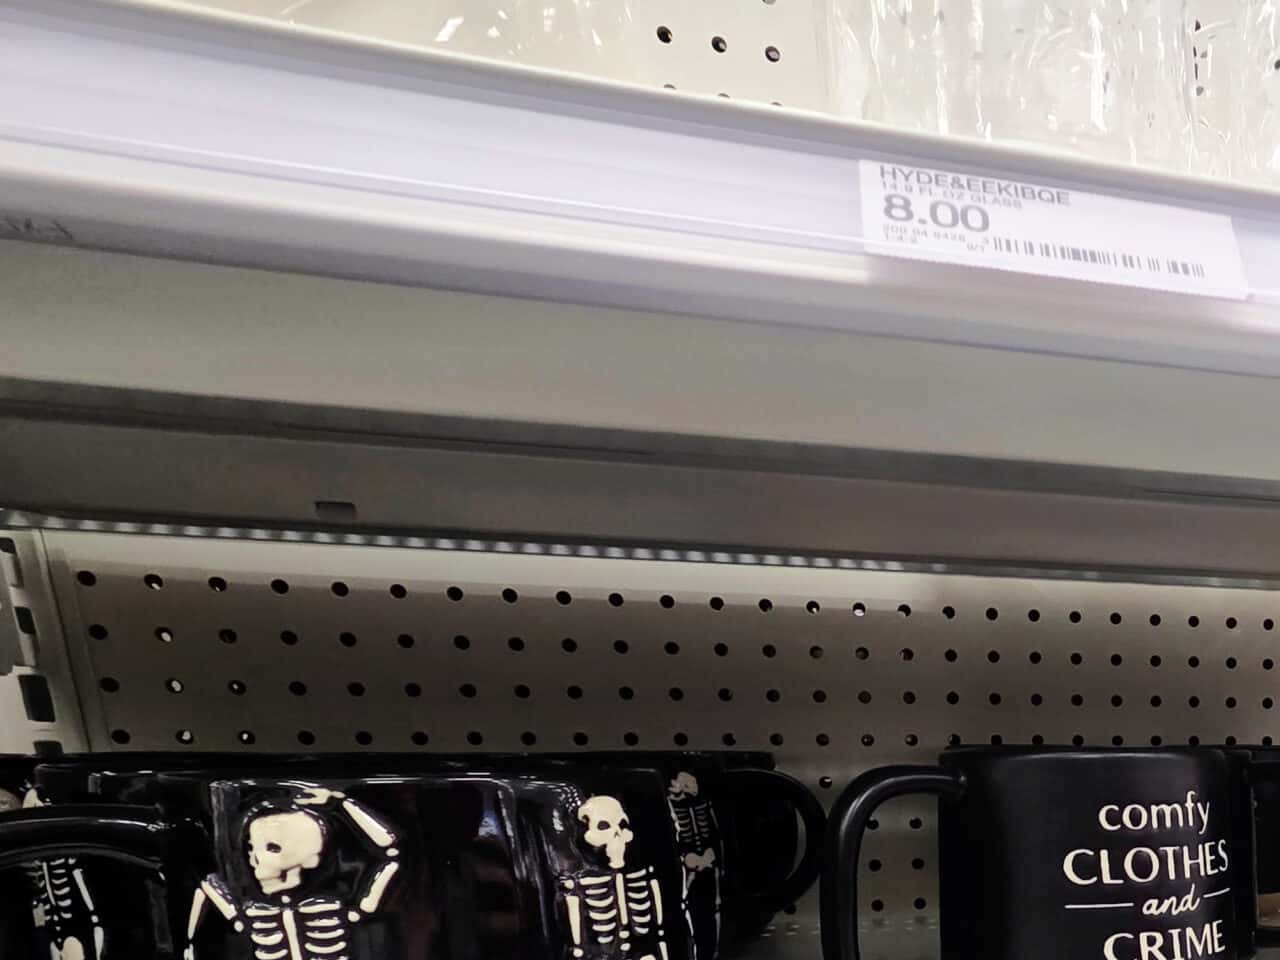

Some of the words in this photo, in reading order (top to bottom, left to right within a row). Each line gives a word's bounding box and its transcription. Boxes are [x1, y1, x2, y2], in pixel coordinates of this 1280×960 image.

[883, 194, 990, 232] 8.00
[1098, 790, 1210, 834] comfy
[1063, 839, 1229, 885] CLOTHES
[1142, 884, 1201, 916] and
